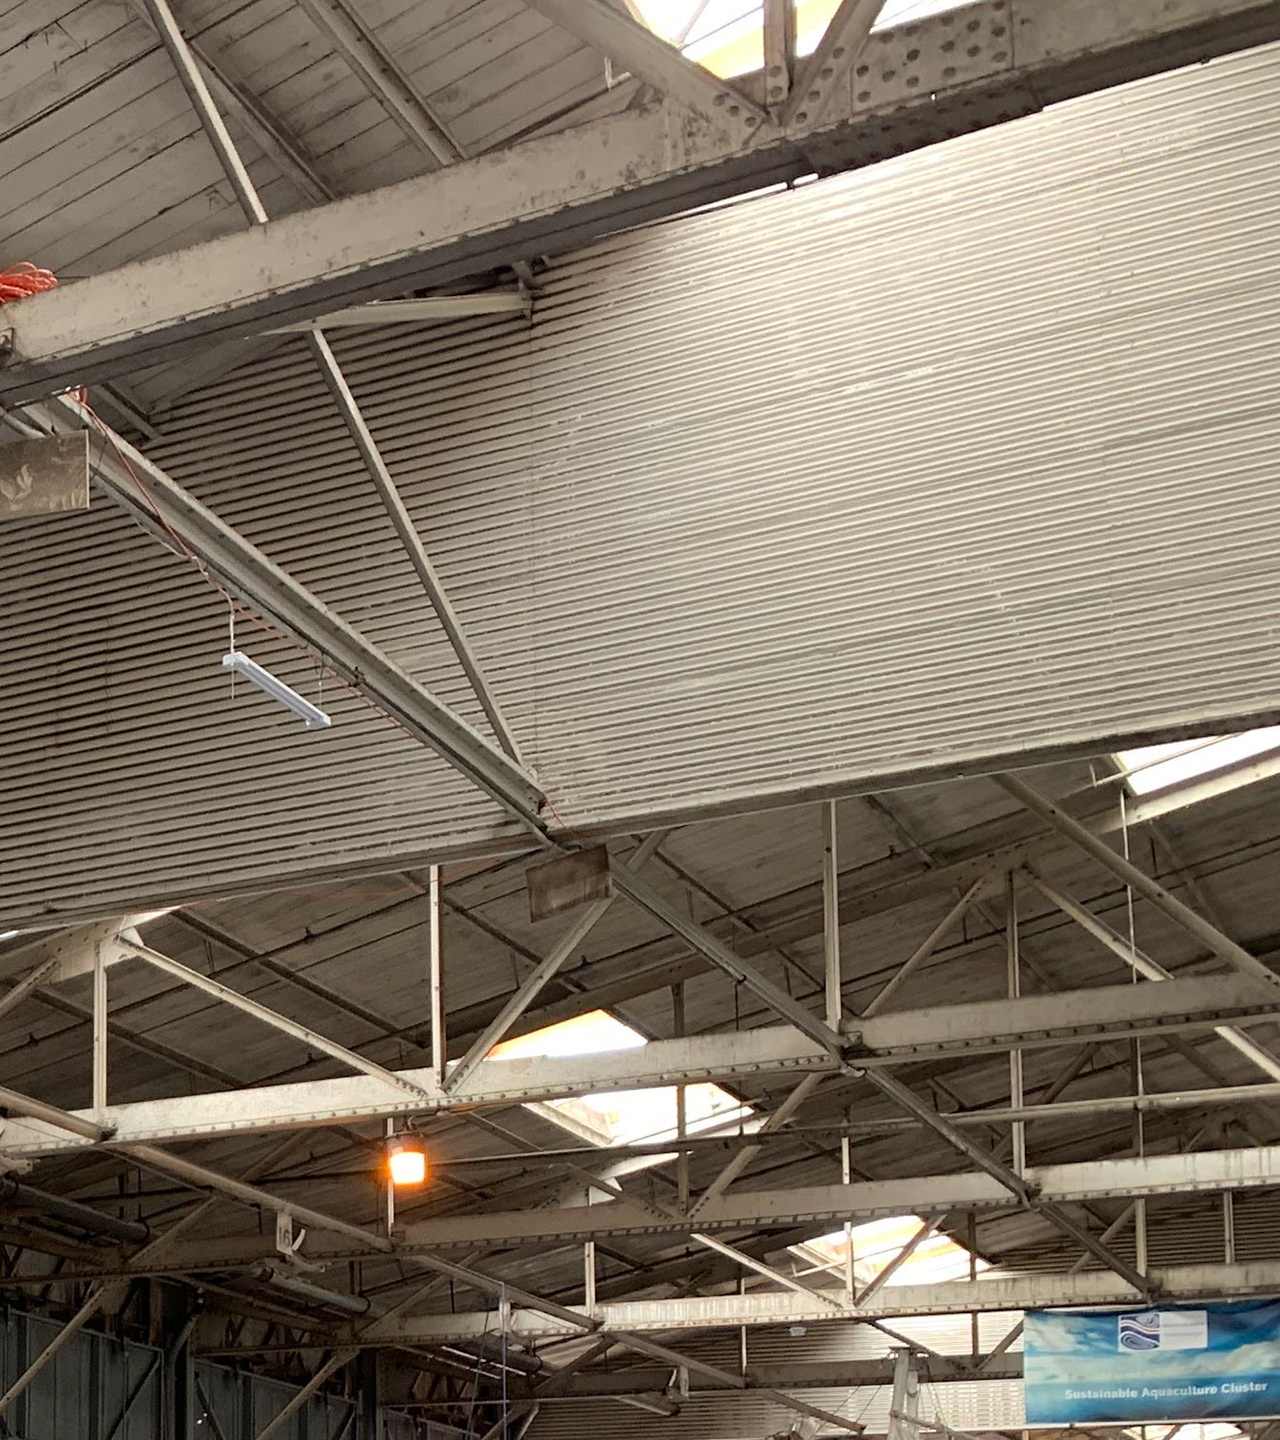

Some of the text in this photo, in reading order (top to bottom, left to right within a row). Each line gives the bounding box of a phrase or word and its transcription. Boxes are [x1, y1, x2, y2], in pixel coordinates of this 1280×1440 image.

[1065, 1381, 1268, 1400] Sustainable Aquaculture Cluster
